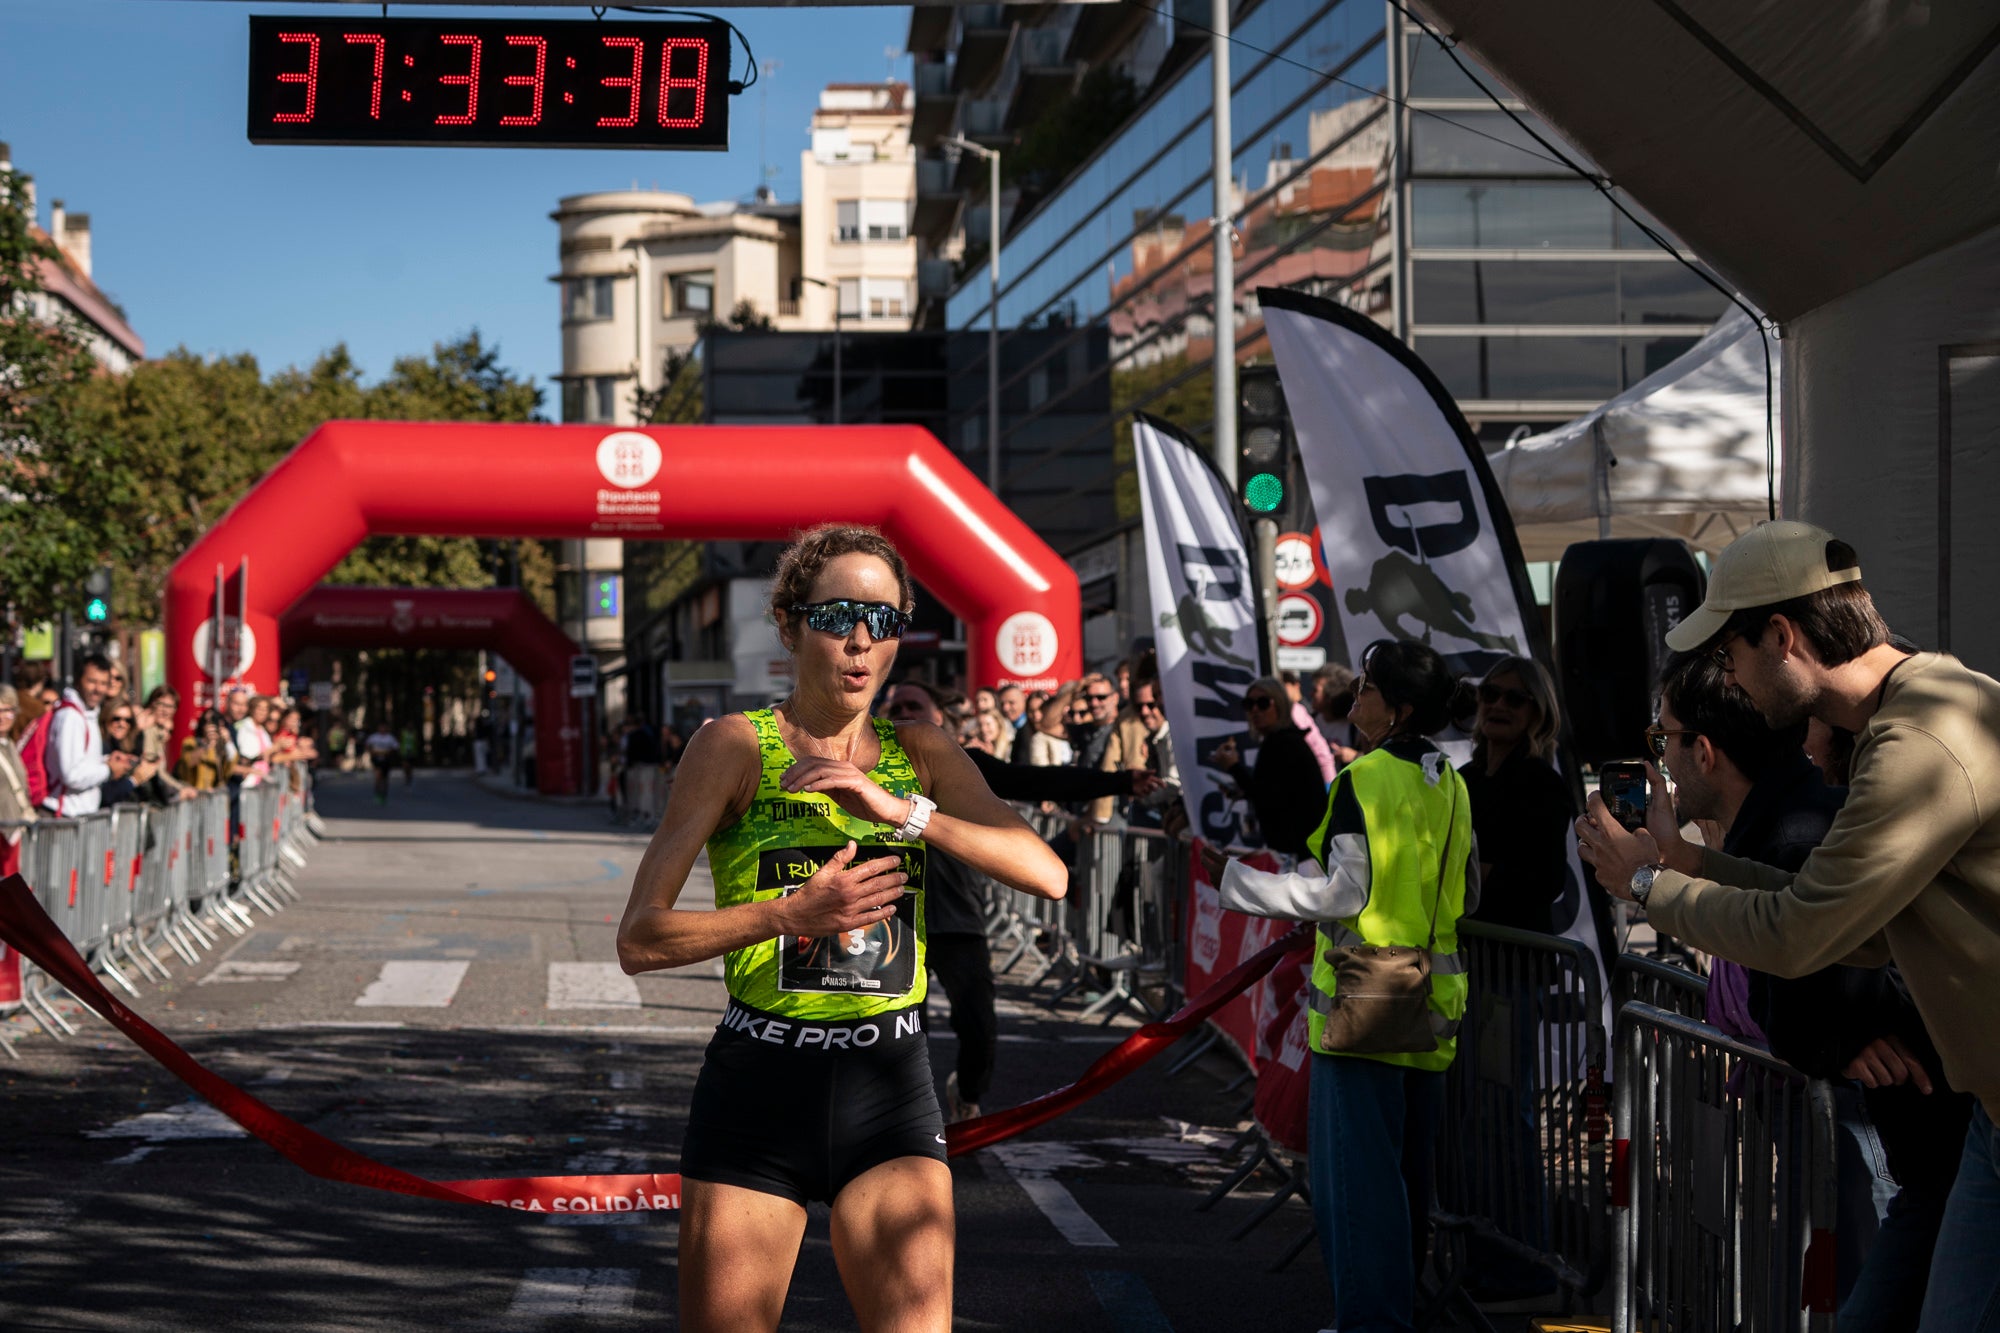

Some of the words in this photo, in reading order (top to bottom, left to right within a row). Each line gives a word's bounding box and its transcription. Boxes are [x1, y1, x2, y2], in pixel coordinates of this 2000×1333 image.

[273, 32, 709, 128] 37:33:38
[847, 928, 866, 956] 3
[723, 1003, 792, 1045] NIKE
[794, 1023, 880, 1050] PRO
[552, 1189, 681, 1213] SOLIDÀRI
